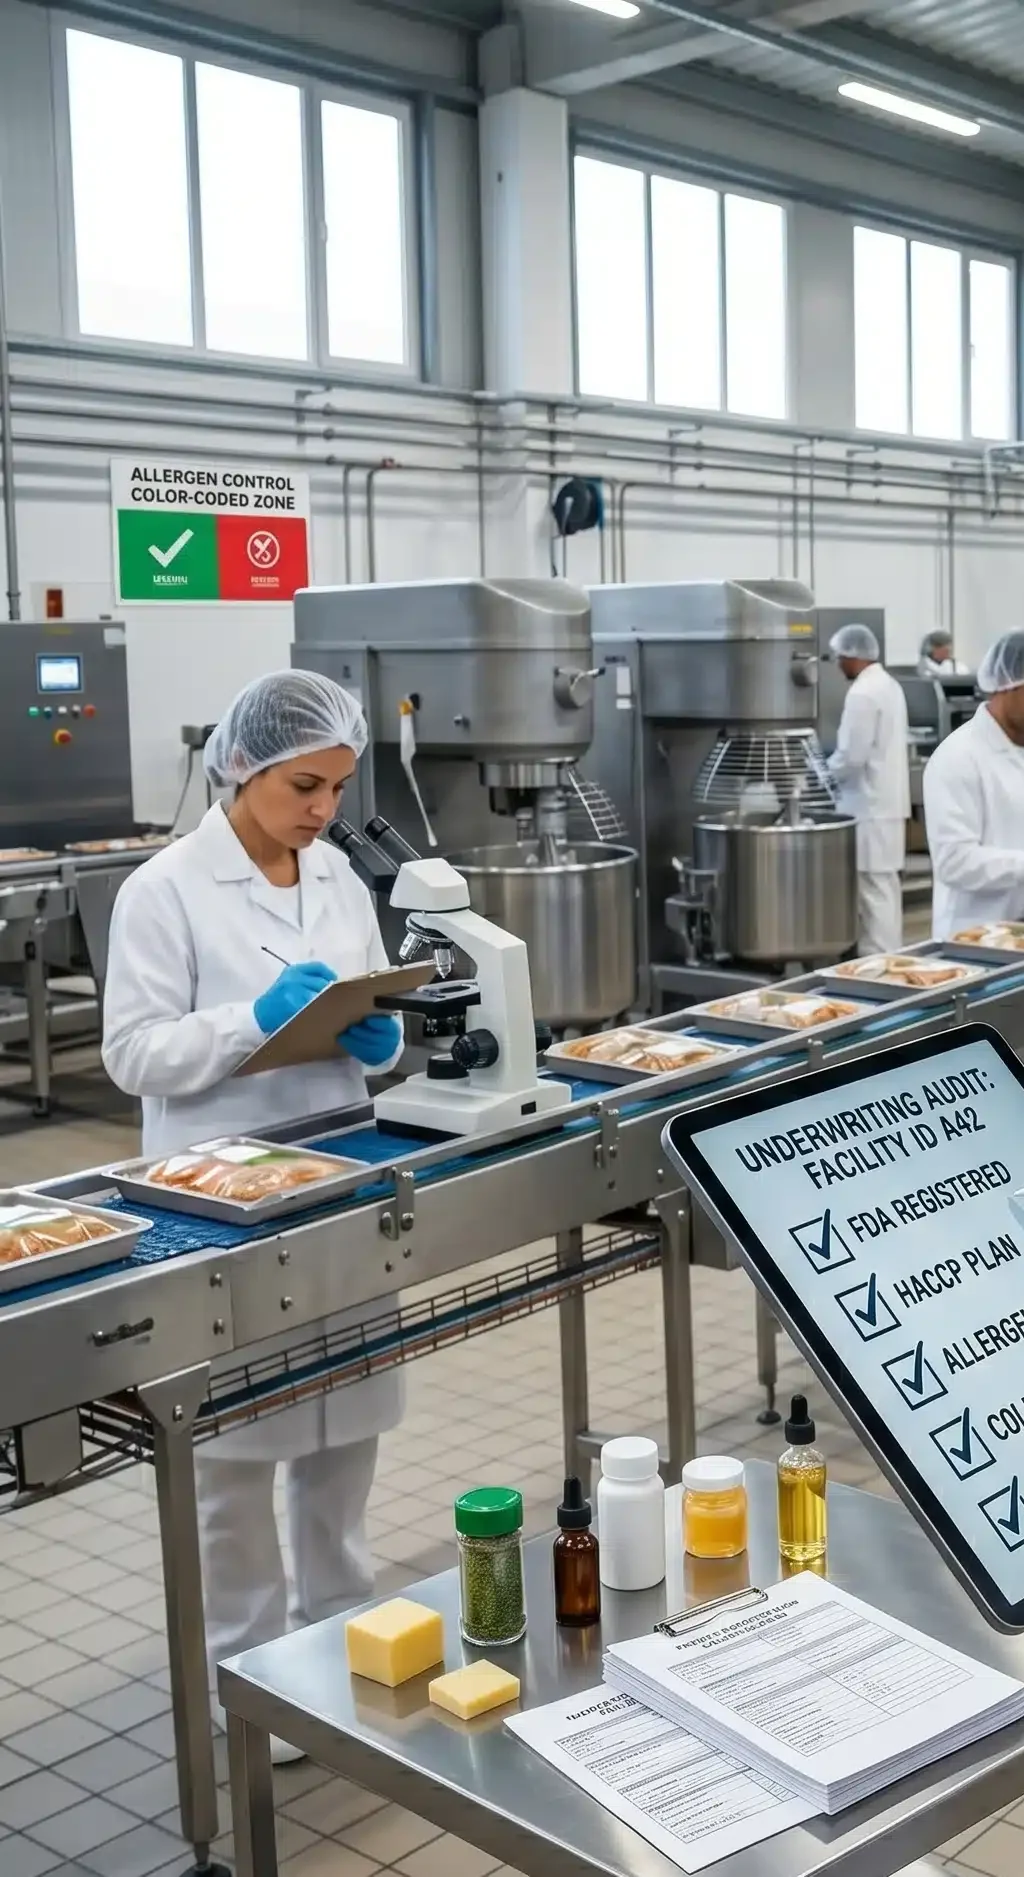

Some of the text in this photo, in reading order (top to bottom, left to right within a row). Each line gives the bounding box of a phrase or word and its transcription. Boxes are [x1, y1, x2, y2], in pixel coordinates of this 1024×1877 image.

[131, 467, 295, 491] ALLERGEN CONTROL
[131, 488, 295, 510] COLOR-CODED ZONE
[735, 1068, 995, 1173] UNDERWRITING AUDIT:
[803, 1106, 986, 1190] FACILITY ID A42
[847, 1160, 1012, 1243] FDA REGISTERED
[893, 1233, 1022, 1309] HACCP PLAN
